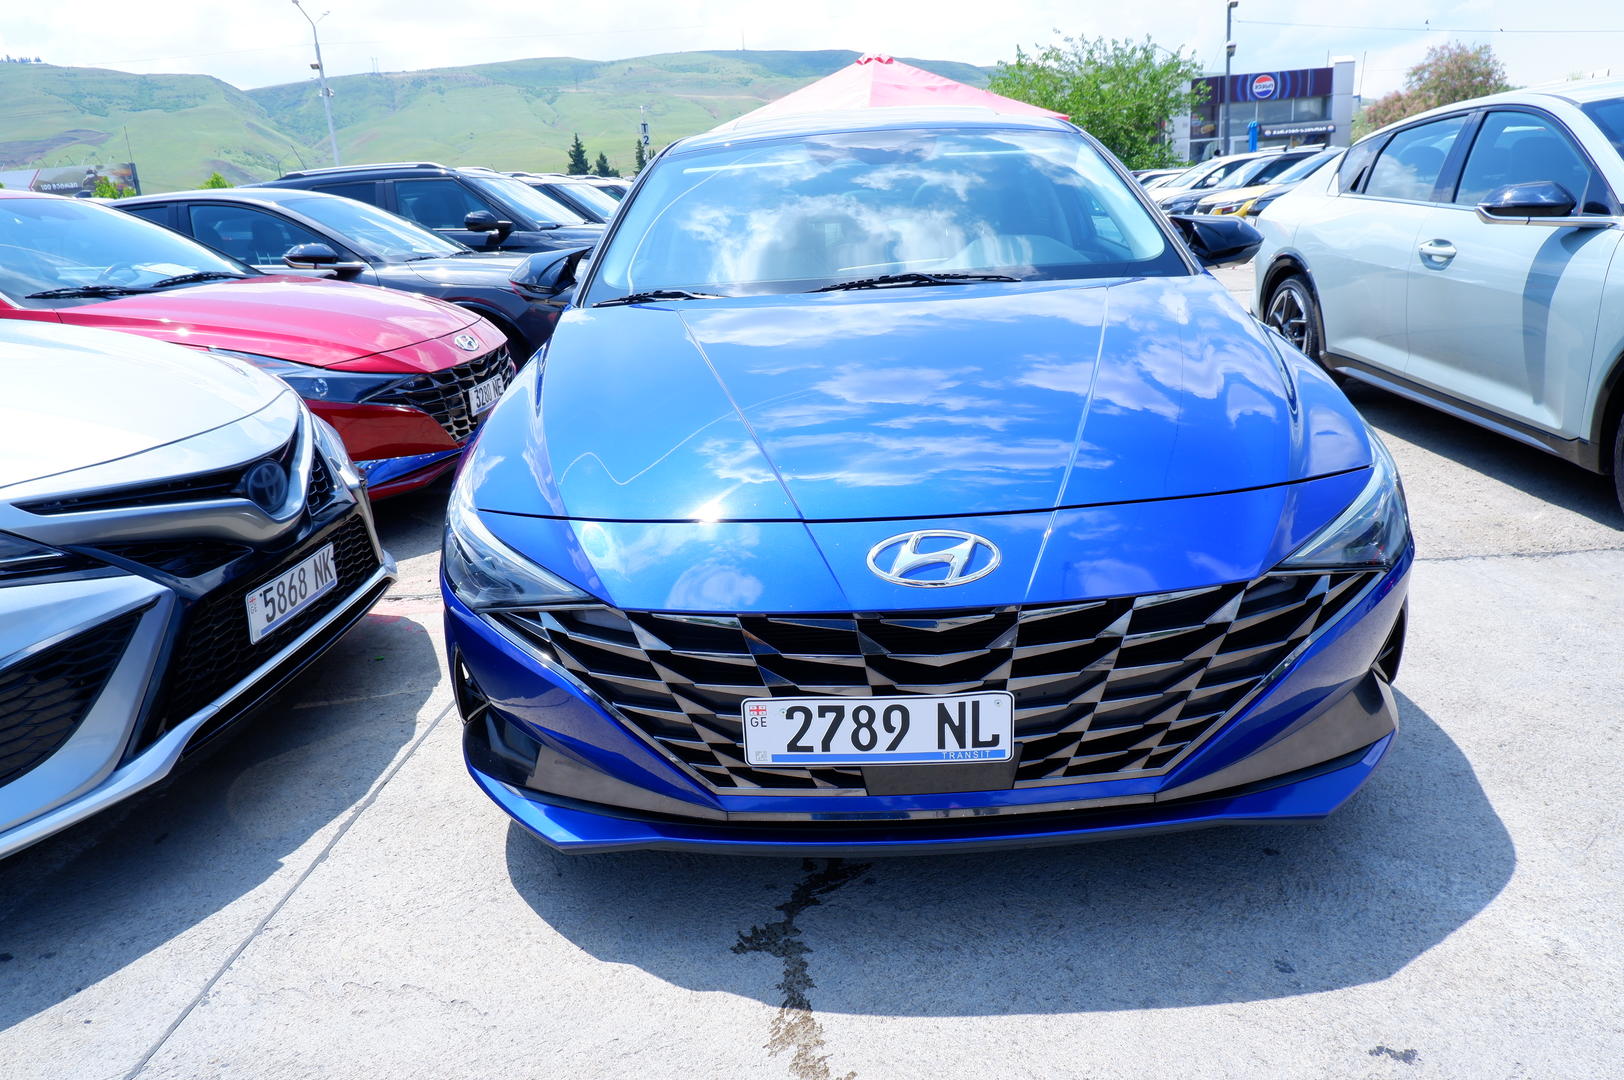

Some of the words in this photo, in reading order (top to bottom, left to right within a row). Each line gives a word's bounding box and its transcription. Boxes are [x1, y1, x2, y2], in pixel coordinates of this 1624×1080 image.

[492, 377, 504, 398] NE
[262, 567, 307, 623] 5868
[313, 549, 333, 590] NK
[750, 717, 767, 727] GE
[785, 704, 910, 753] 2789
[937, 700, 1000, 750] NL
[942, 751, 991, 760] TRANSIT
